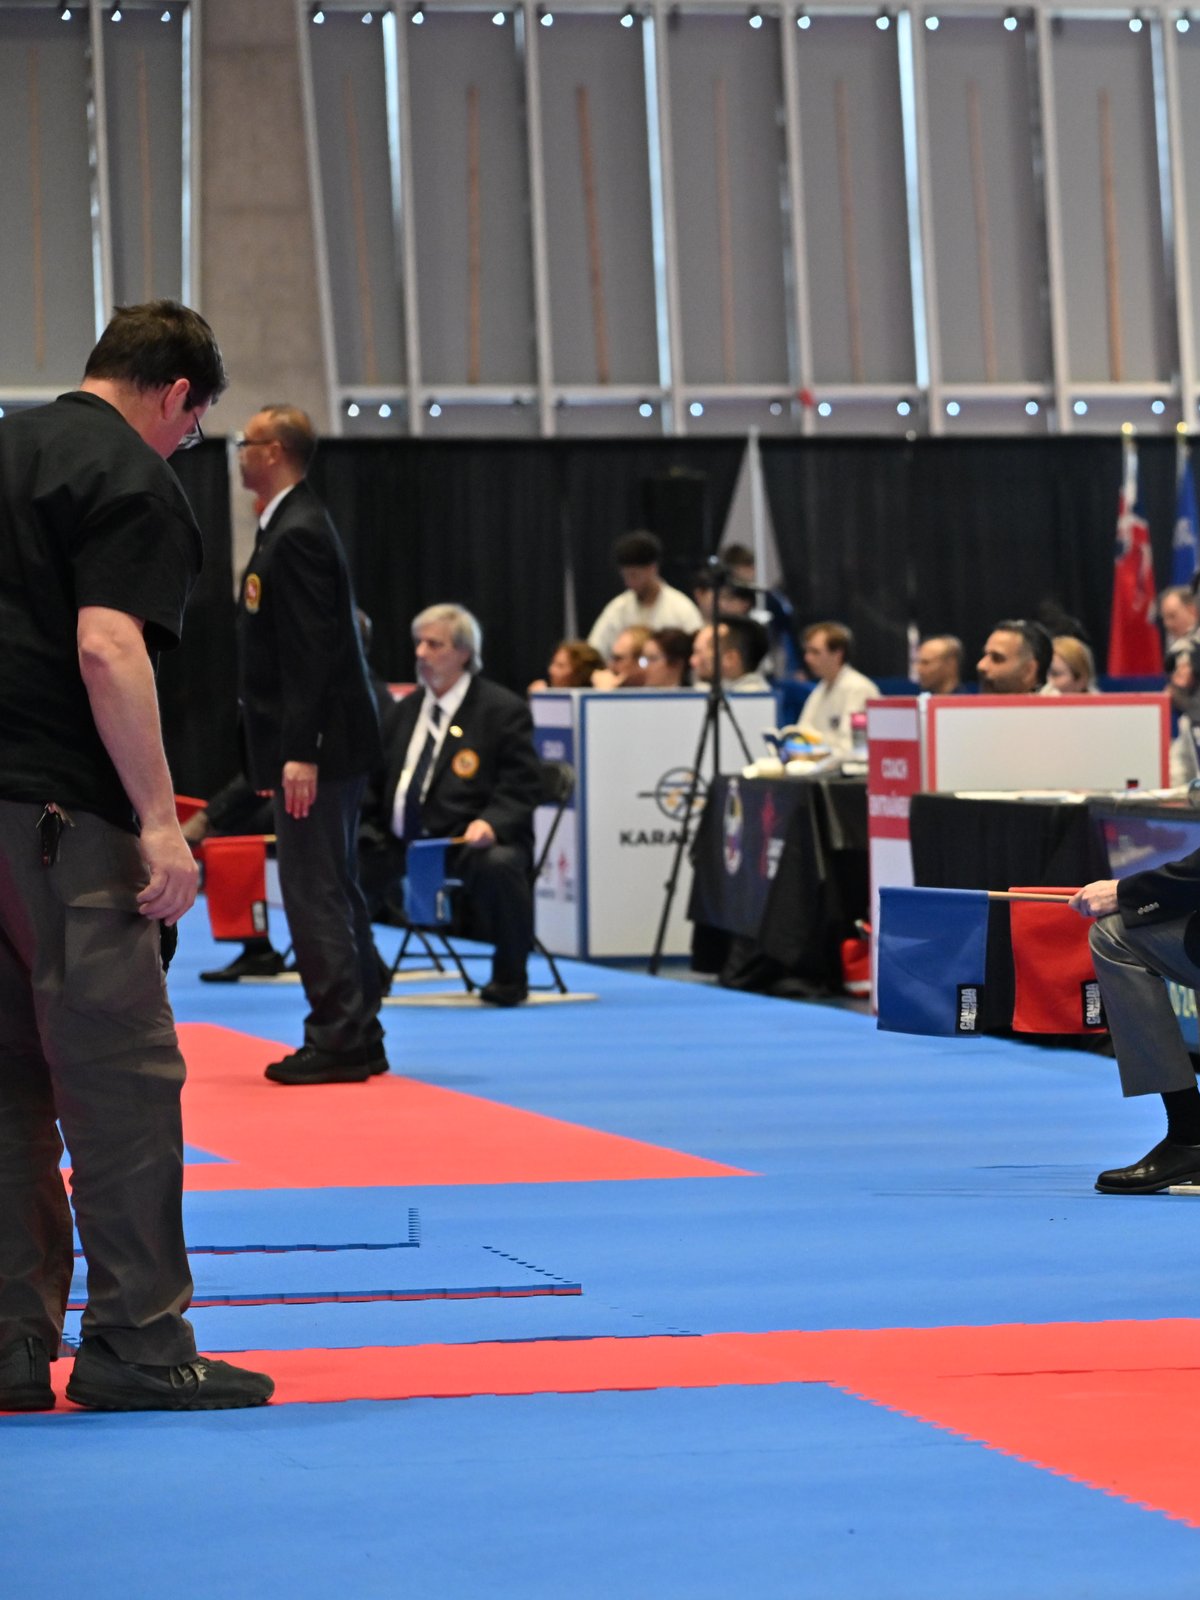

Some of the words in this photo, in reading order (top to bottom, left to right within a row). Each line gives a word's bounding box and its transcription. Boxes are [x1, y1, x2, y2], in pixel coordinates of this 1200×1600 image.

[619, 828, 688, 848] KARA
[960, 988, 973, 1031] CANADA
[1085, 983, 1098, 1025] CANADA
